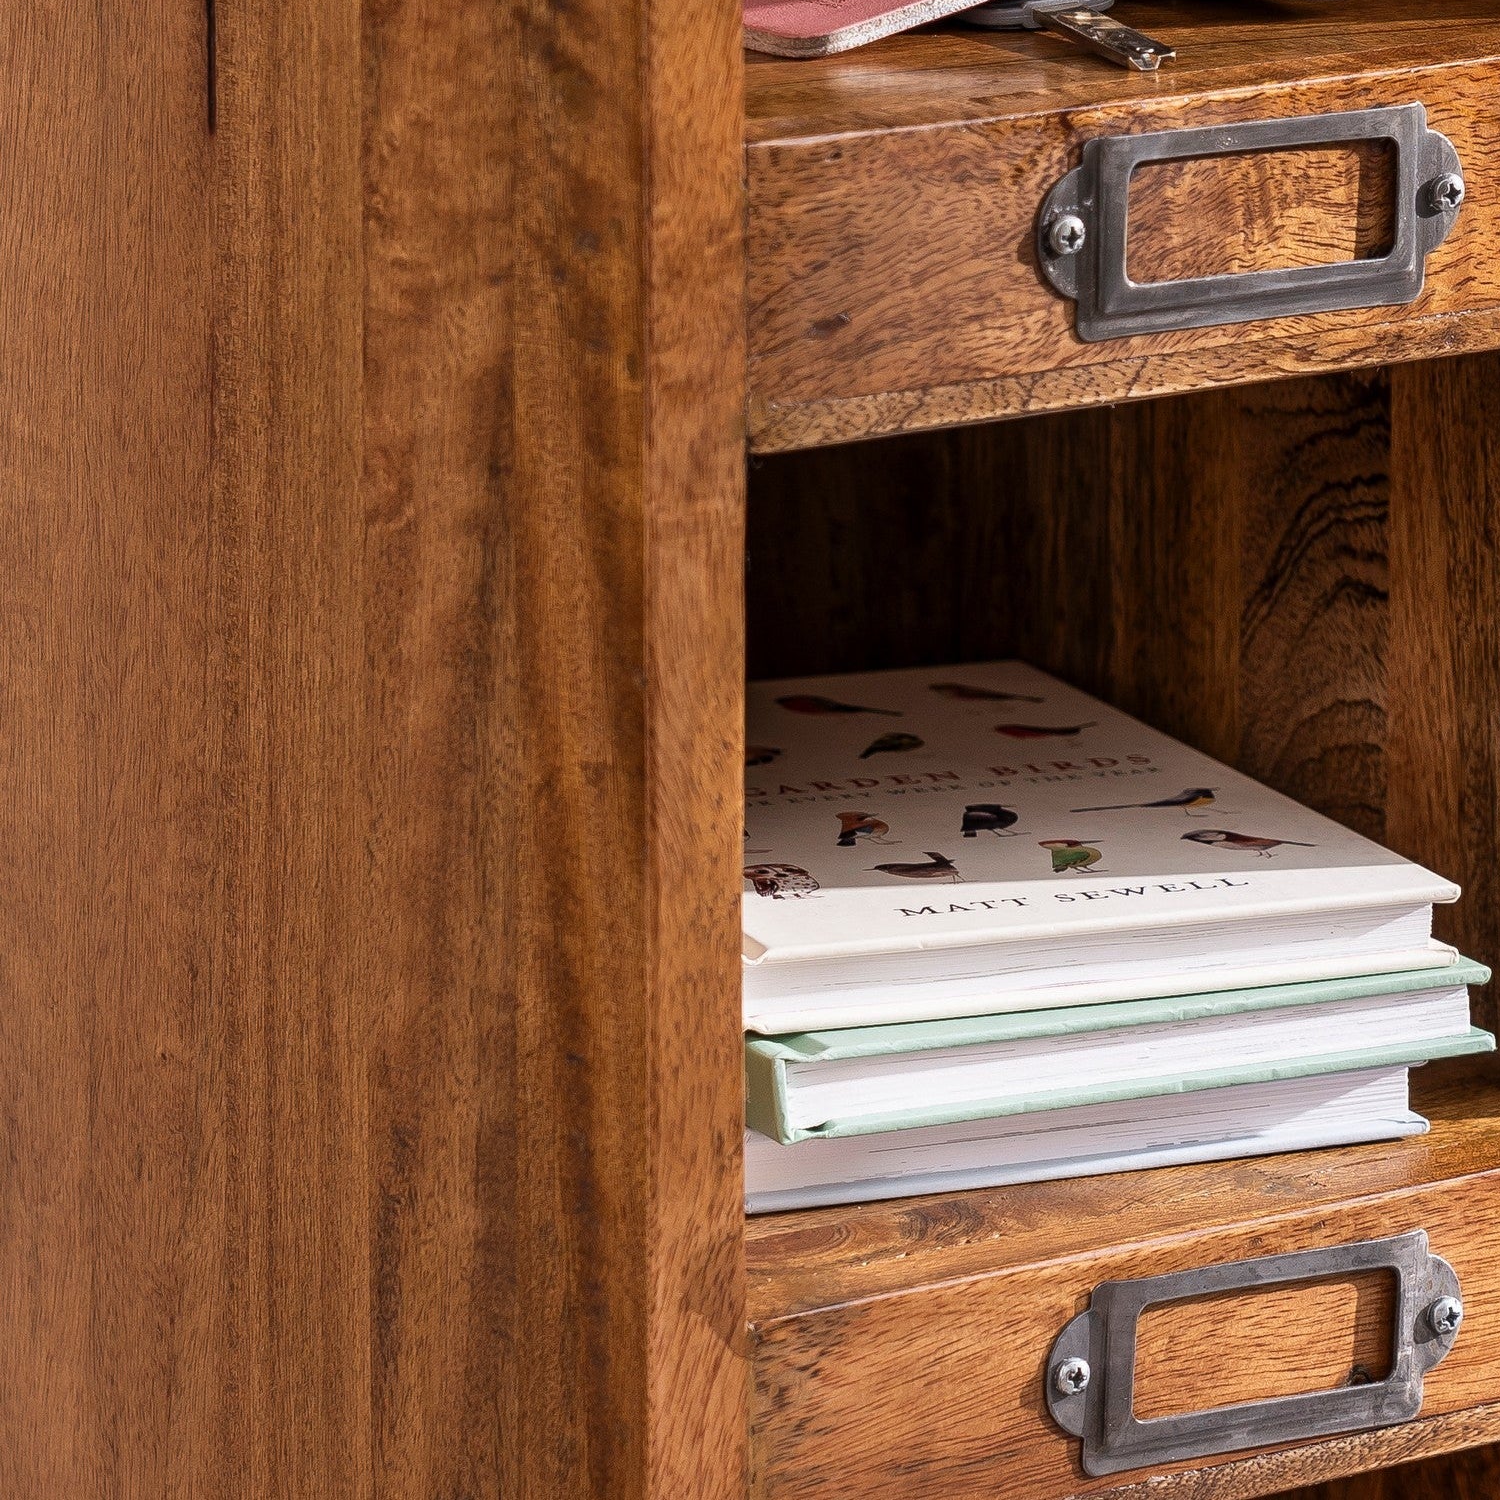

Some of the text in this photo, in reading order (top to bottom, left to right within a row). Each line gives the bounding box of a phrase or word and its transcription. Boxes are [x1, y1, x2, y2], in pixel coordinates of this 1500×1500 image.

[986, 754, 1152, 777] BIRDS
[894, 877, 1250, 918] MATT SEWELL
